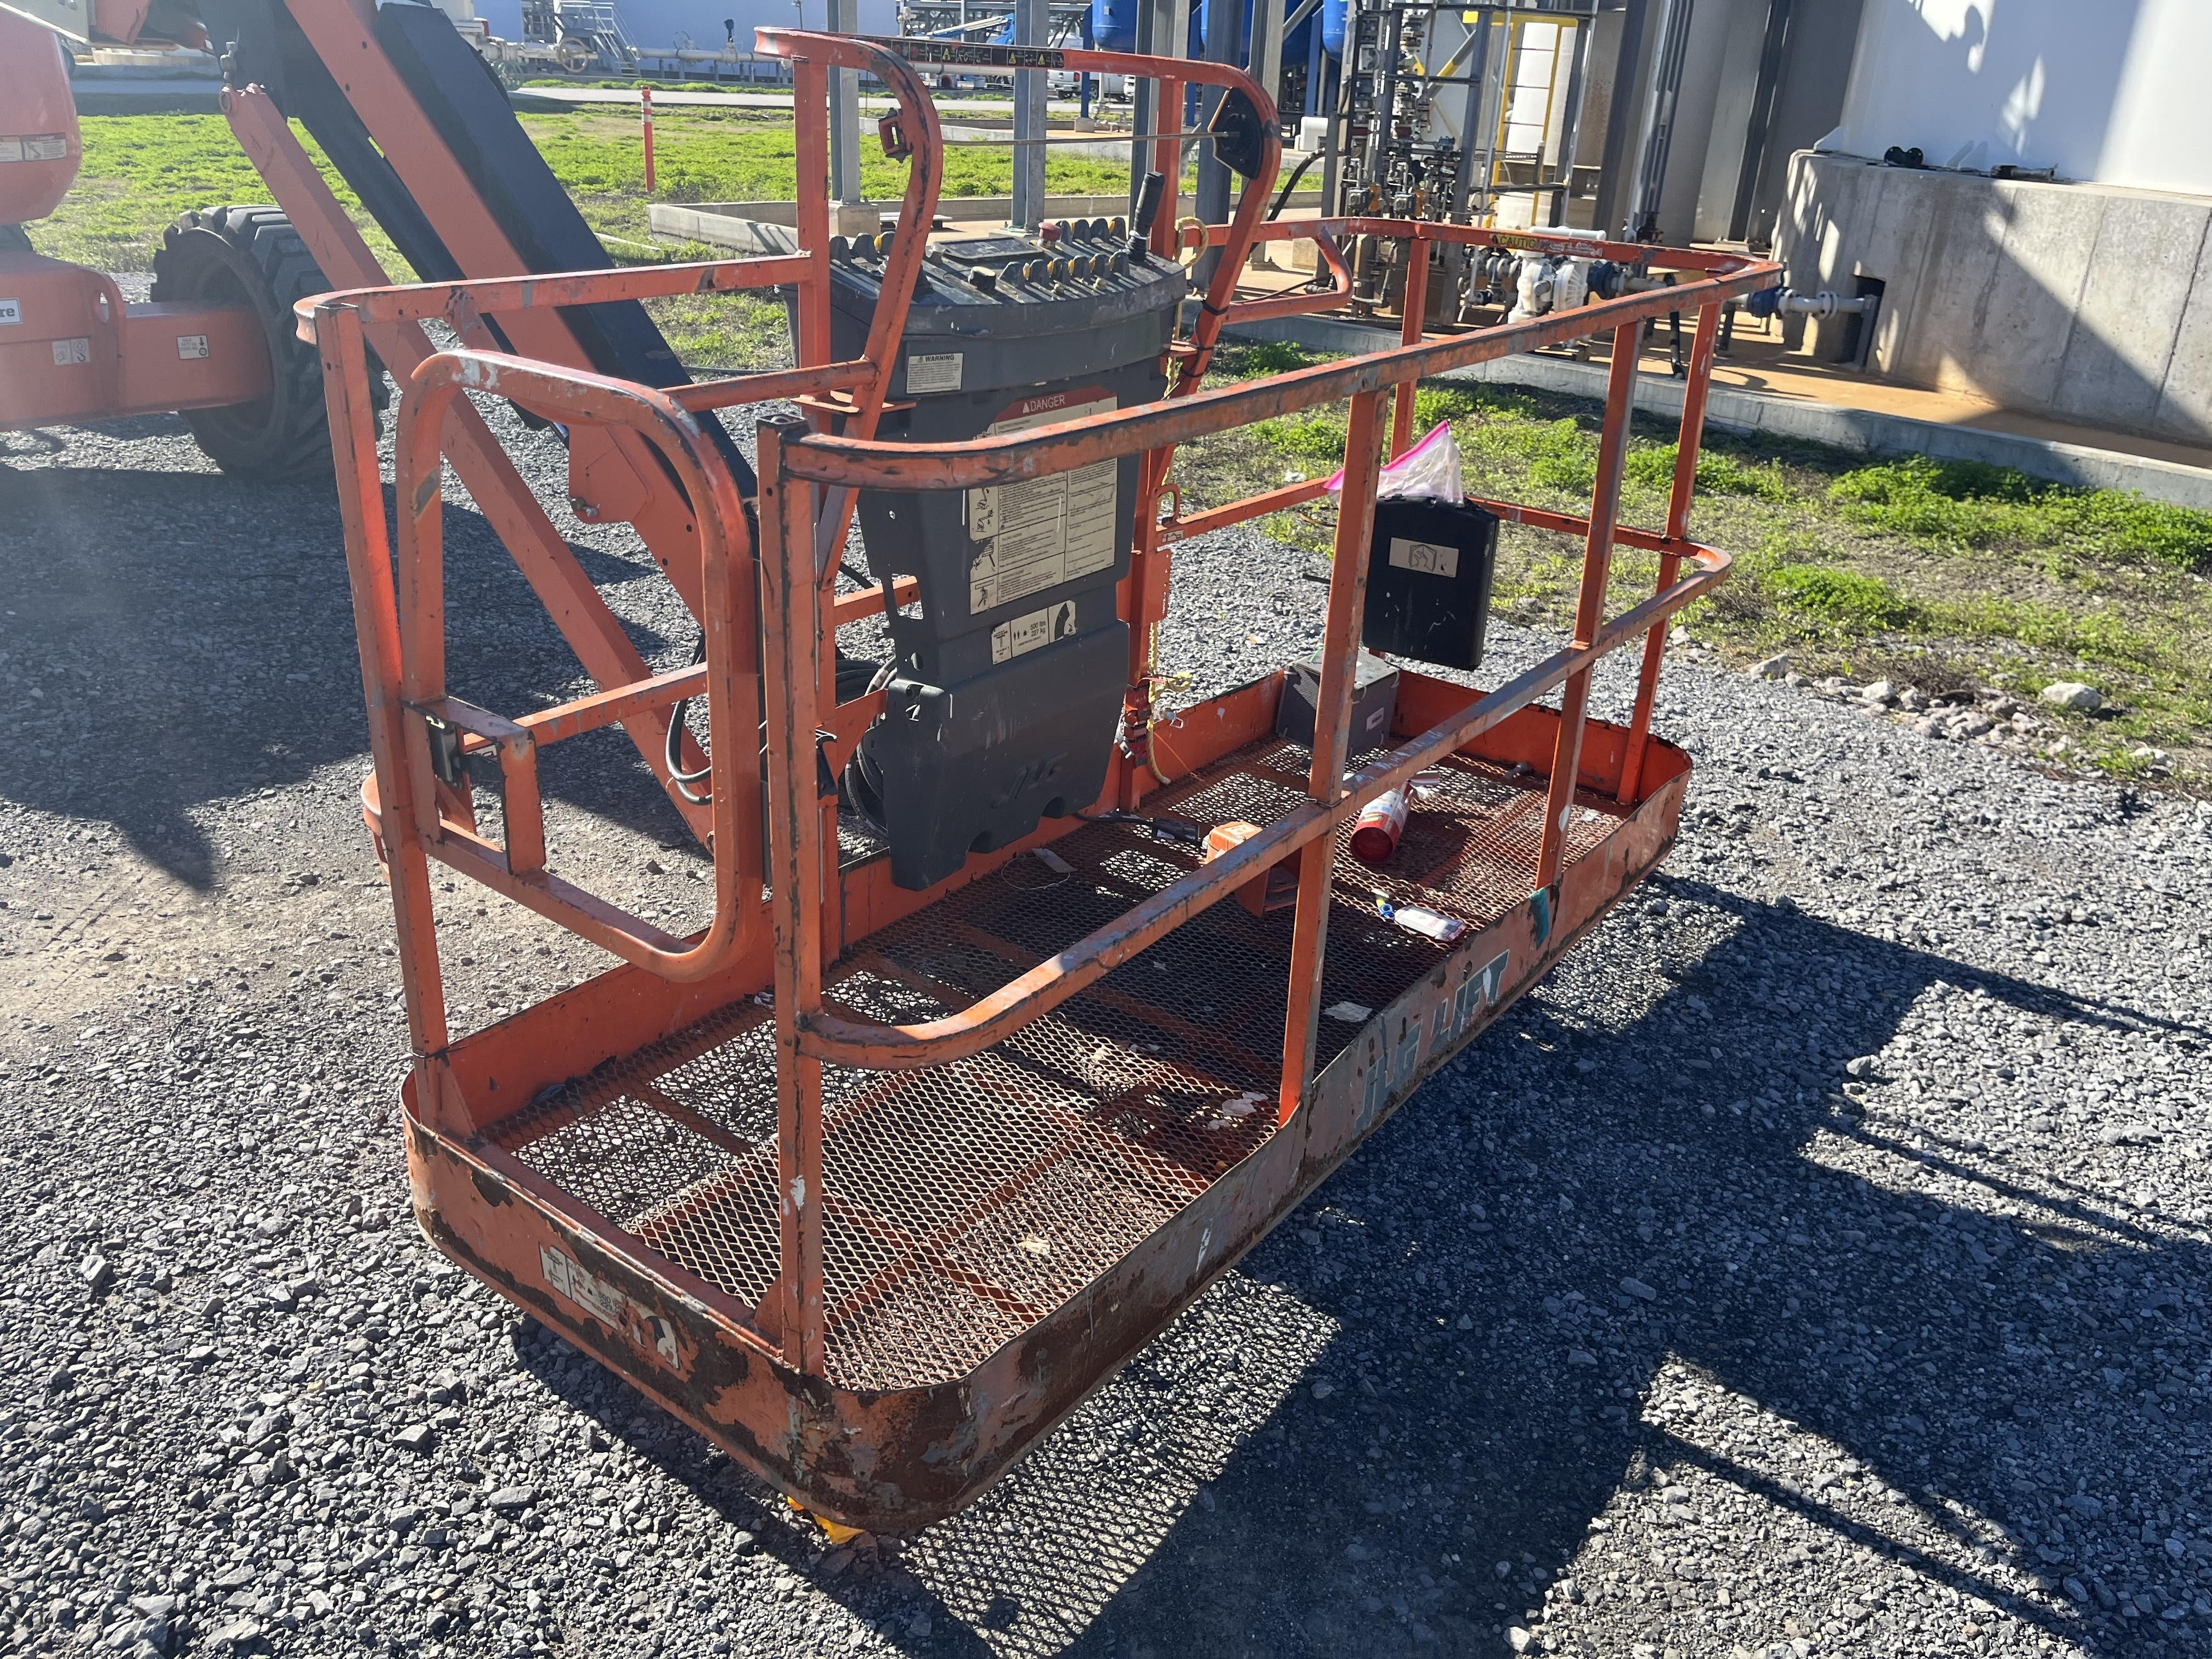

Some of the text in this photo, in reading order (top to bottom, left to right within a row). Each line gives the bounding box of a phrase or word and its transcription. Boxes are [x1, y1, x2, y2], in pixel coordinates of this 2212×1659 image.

[1030, 394, 1065, 412] DANGER
[1031, 629, 1039, 637] 227
[1429, 949, 1510, 1056] LIFT
